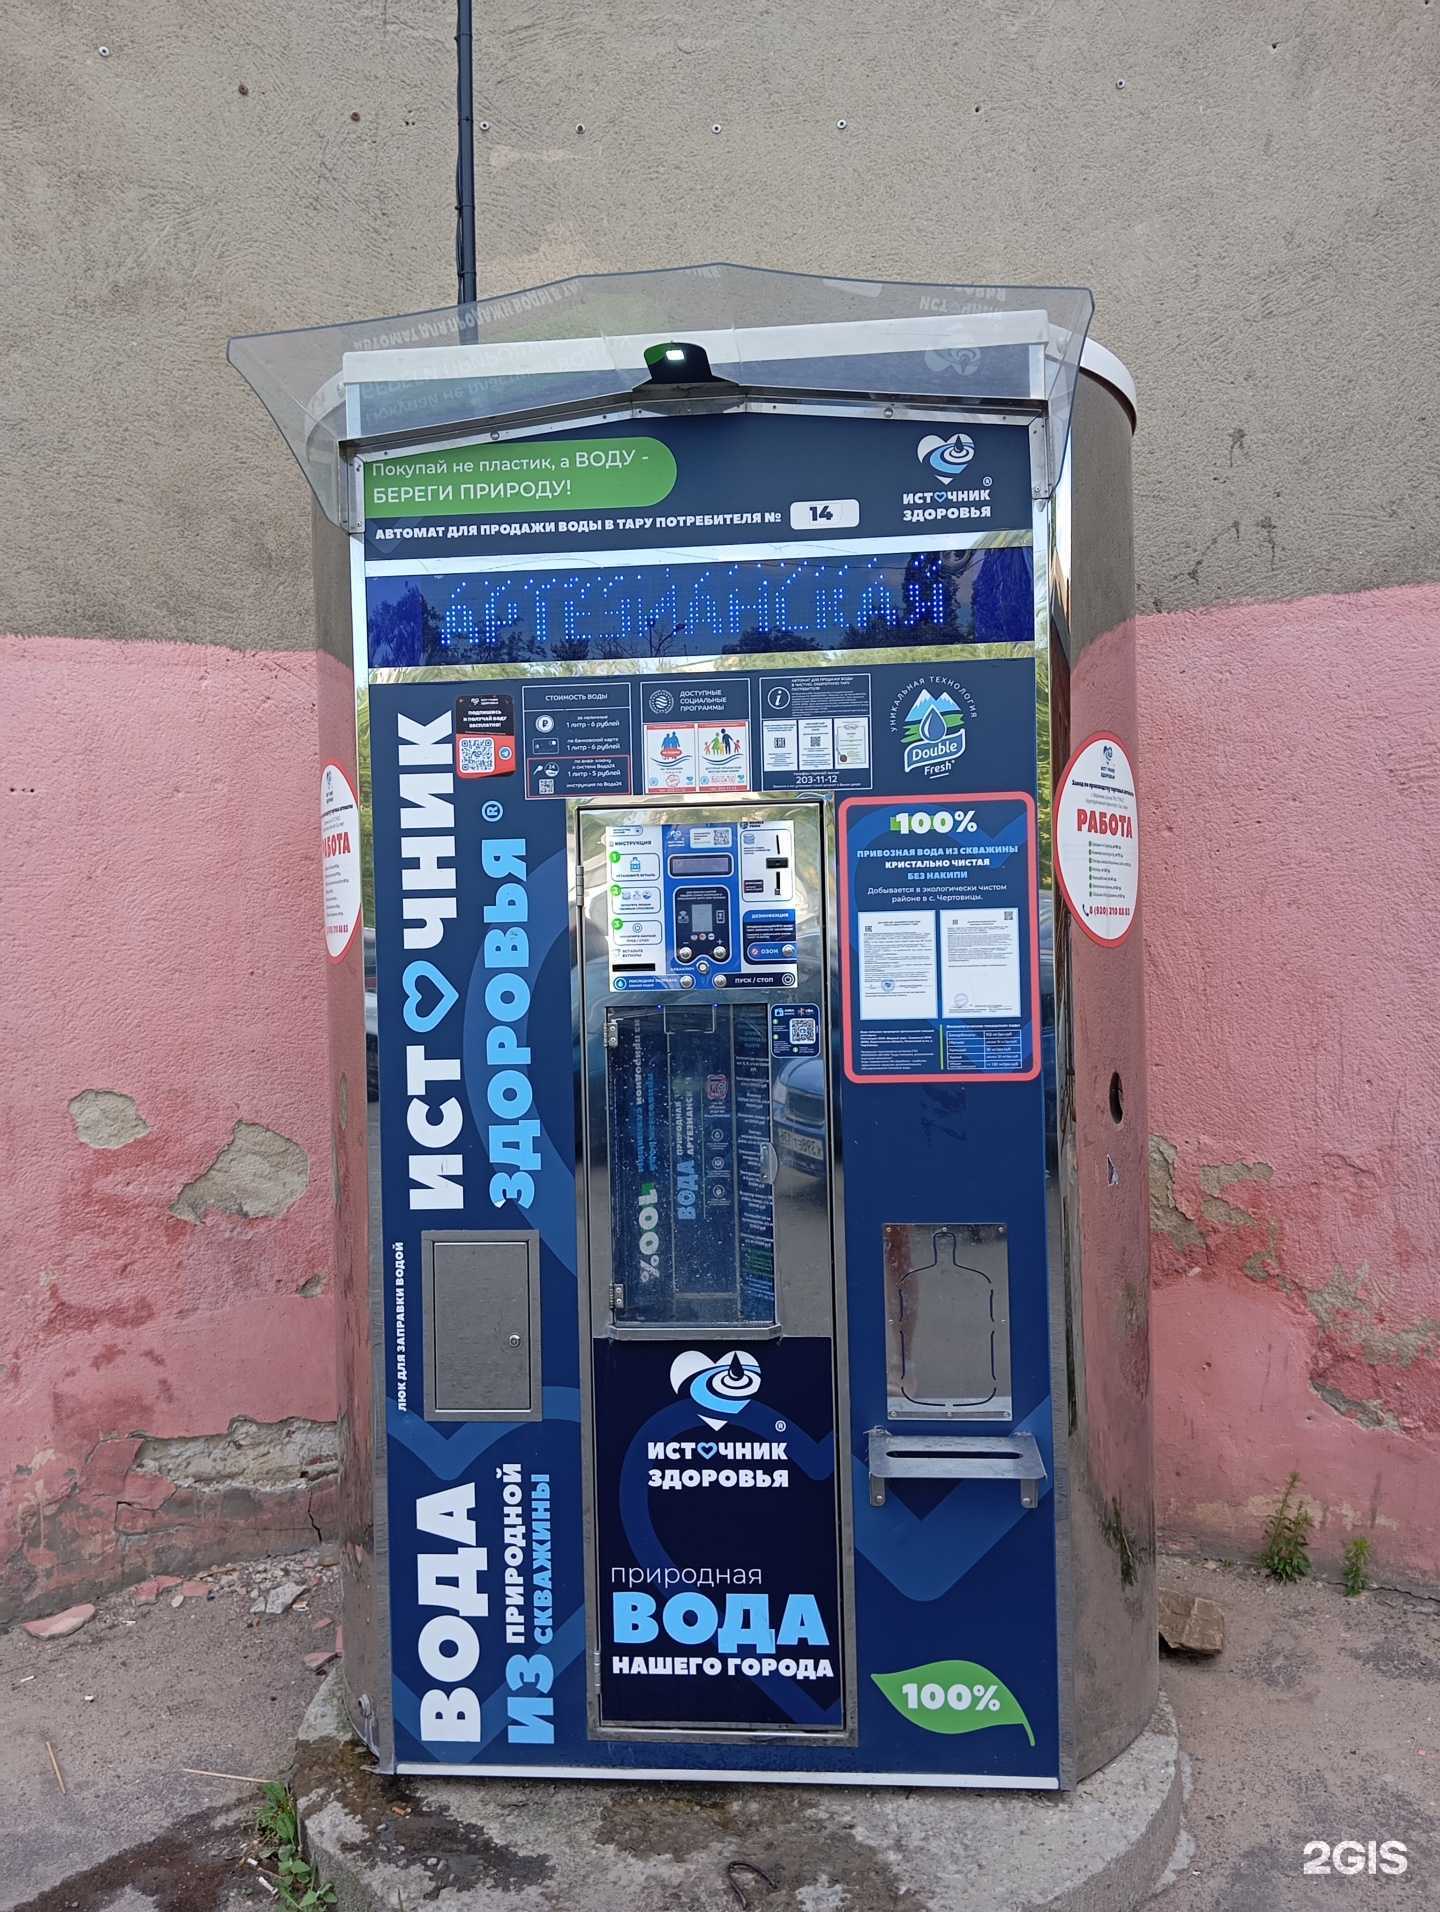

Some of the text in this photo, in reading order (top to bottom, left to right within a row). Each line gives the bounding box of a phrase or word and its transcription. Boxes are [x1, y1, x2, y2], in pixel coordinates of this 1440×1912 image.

[373, 462, 447, 478] Покупай
[453, 460, 474, 474] не
[479, 457, 555, 473] пластик,
[560, 458, 570, 469] а
[576, 449, 635, 467] ВОДУ
[373, 480, 572, 504] БЕРЕГИ ПРИРОДУ!
[809, 505, 833, 522] 14
[903, 506, 991, 522] ЗДОРОВЬЯ
[376, 511, 782, 540] АВТОМАТ ДЛЯ ПРОДАЖИ ВОДЫ В ТАРУ ПОТРЕБИТЕЛЯ №
[680, 689, 722, 699] ДОСТУПНЫЕ
[680, 696, 728, 706] СОЦИАЛЬНЫЕ
[889, 678, 926, 732] УНИКАЛЬНАЯ
[930, 676, 977, 718] ТЕХНОЛОГИЯ
[680, 704, 725, 712] ПРОГРАММЫ
[571, 721, 587, 729] литр
[596, 720, 620, 729] рублей
[597, 743, 620, 752] рублей
[912, 741, 958, 761] Double
[597, 769, 621, 778] рублей
[924, 761, 952, 775] Fresh
[796, 775, 838, 784] 203-11-12
[897, 810, 977, 834] 100%
[1077, 808, 1133, 838] РАБОТА
[857, 849, 915, 858] ПРИВОЗНАЯ
[916, 848, 944, 857] ВОДА
[960, 845, 1018, 854] СКВАЖИНЫ
[885, 858, 990, 869] КРИСТАЛЬНО ЧИСТАЯ
[908, 871, 968, 880] БЕЗ НАКИПИ
[867, 887, 914, 895] Добывается
[922, 885, 977, 896] экологически
[892, 896, 920, 904] районе
[481, 838, 542, 1209] ЗДОРОВЬЯ
[676, 1159, 698, 1220] ВОДА
[638, 1187, 659, 1283] 100%
[392, 1242, 407, 1412] ЛЮК ДЛЯ ЗАПРАВКИ ВОДОЙ
[648, 1469, 789, 1490] ЗДОРОВЬЯ
[531, 1474, 554, 1645] СКВАЖИНЫ
[611, 1567, 762, 1588] природная
[416, 1481, 489, 1742] ВОДА
[496, 1464, 555, 1744] ИЗ ПРИРОДНОЙ
[612, 1591, 830, 1654] ВОДА
[612, 1656, 834, 1680] НАШЕГО ГОРОДА
[902, 1683, 1001, 1711] 100%
